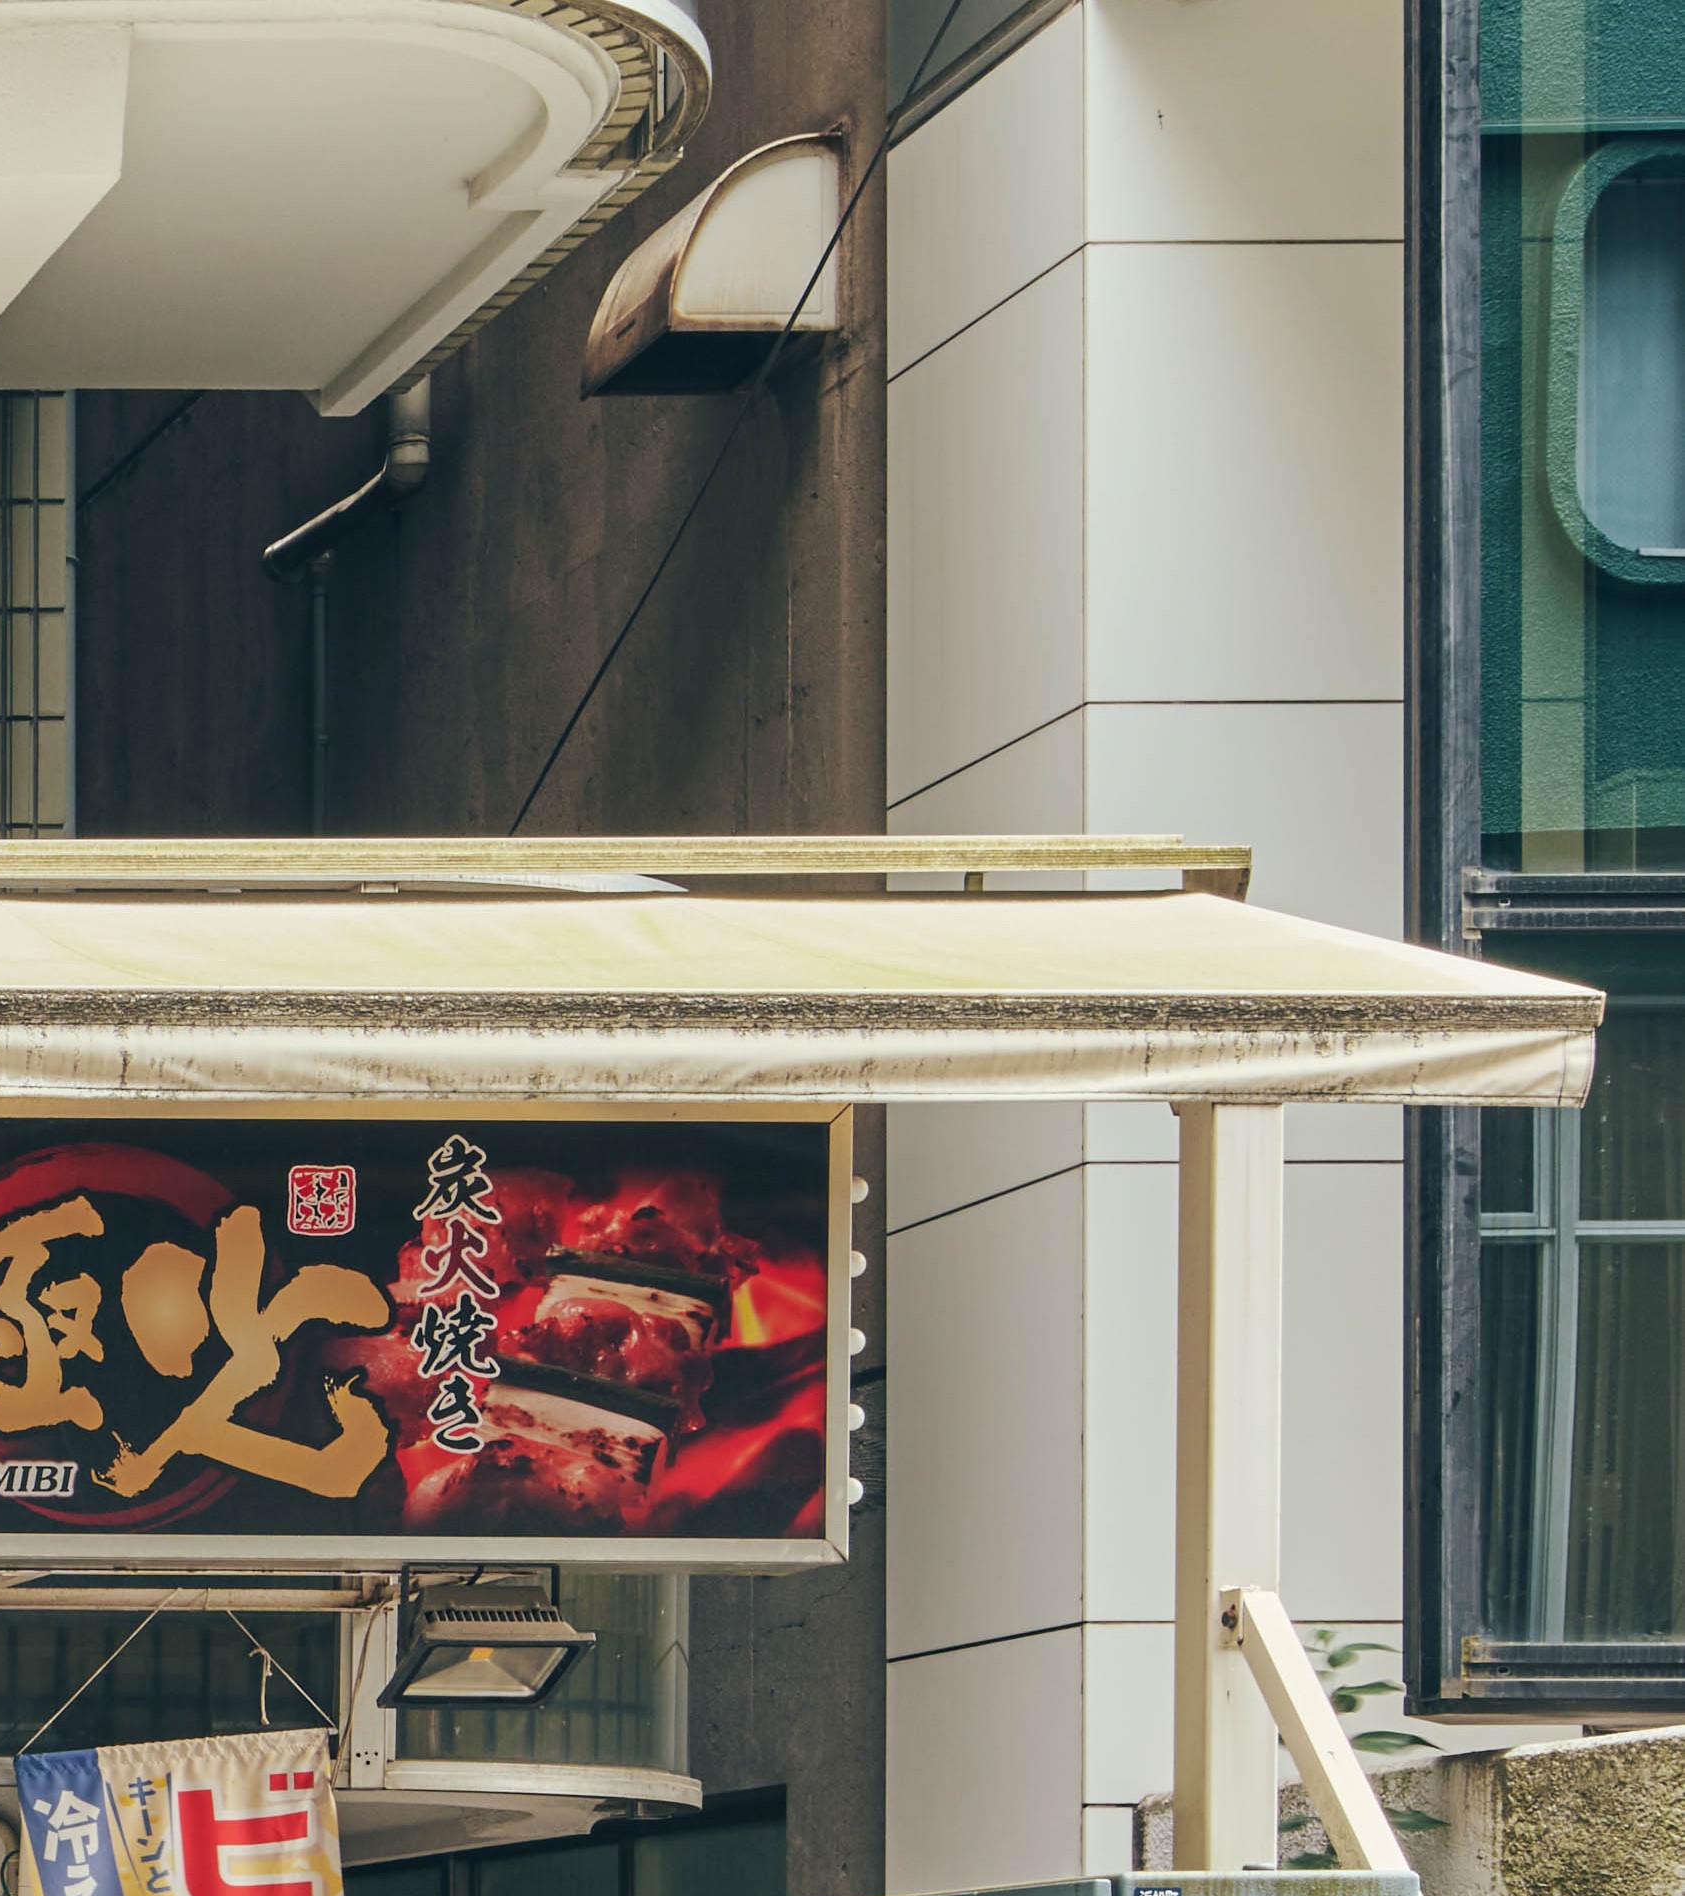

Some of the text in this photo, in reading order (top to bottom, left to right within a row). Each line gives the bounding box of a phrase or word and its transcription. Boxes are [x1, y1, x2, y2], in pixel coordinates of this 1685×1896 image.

[413, 1134, 502, 1453] 炭火焼き
[129, 1777, 171, 1893] キーンと
